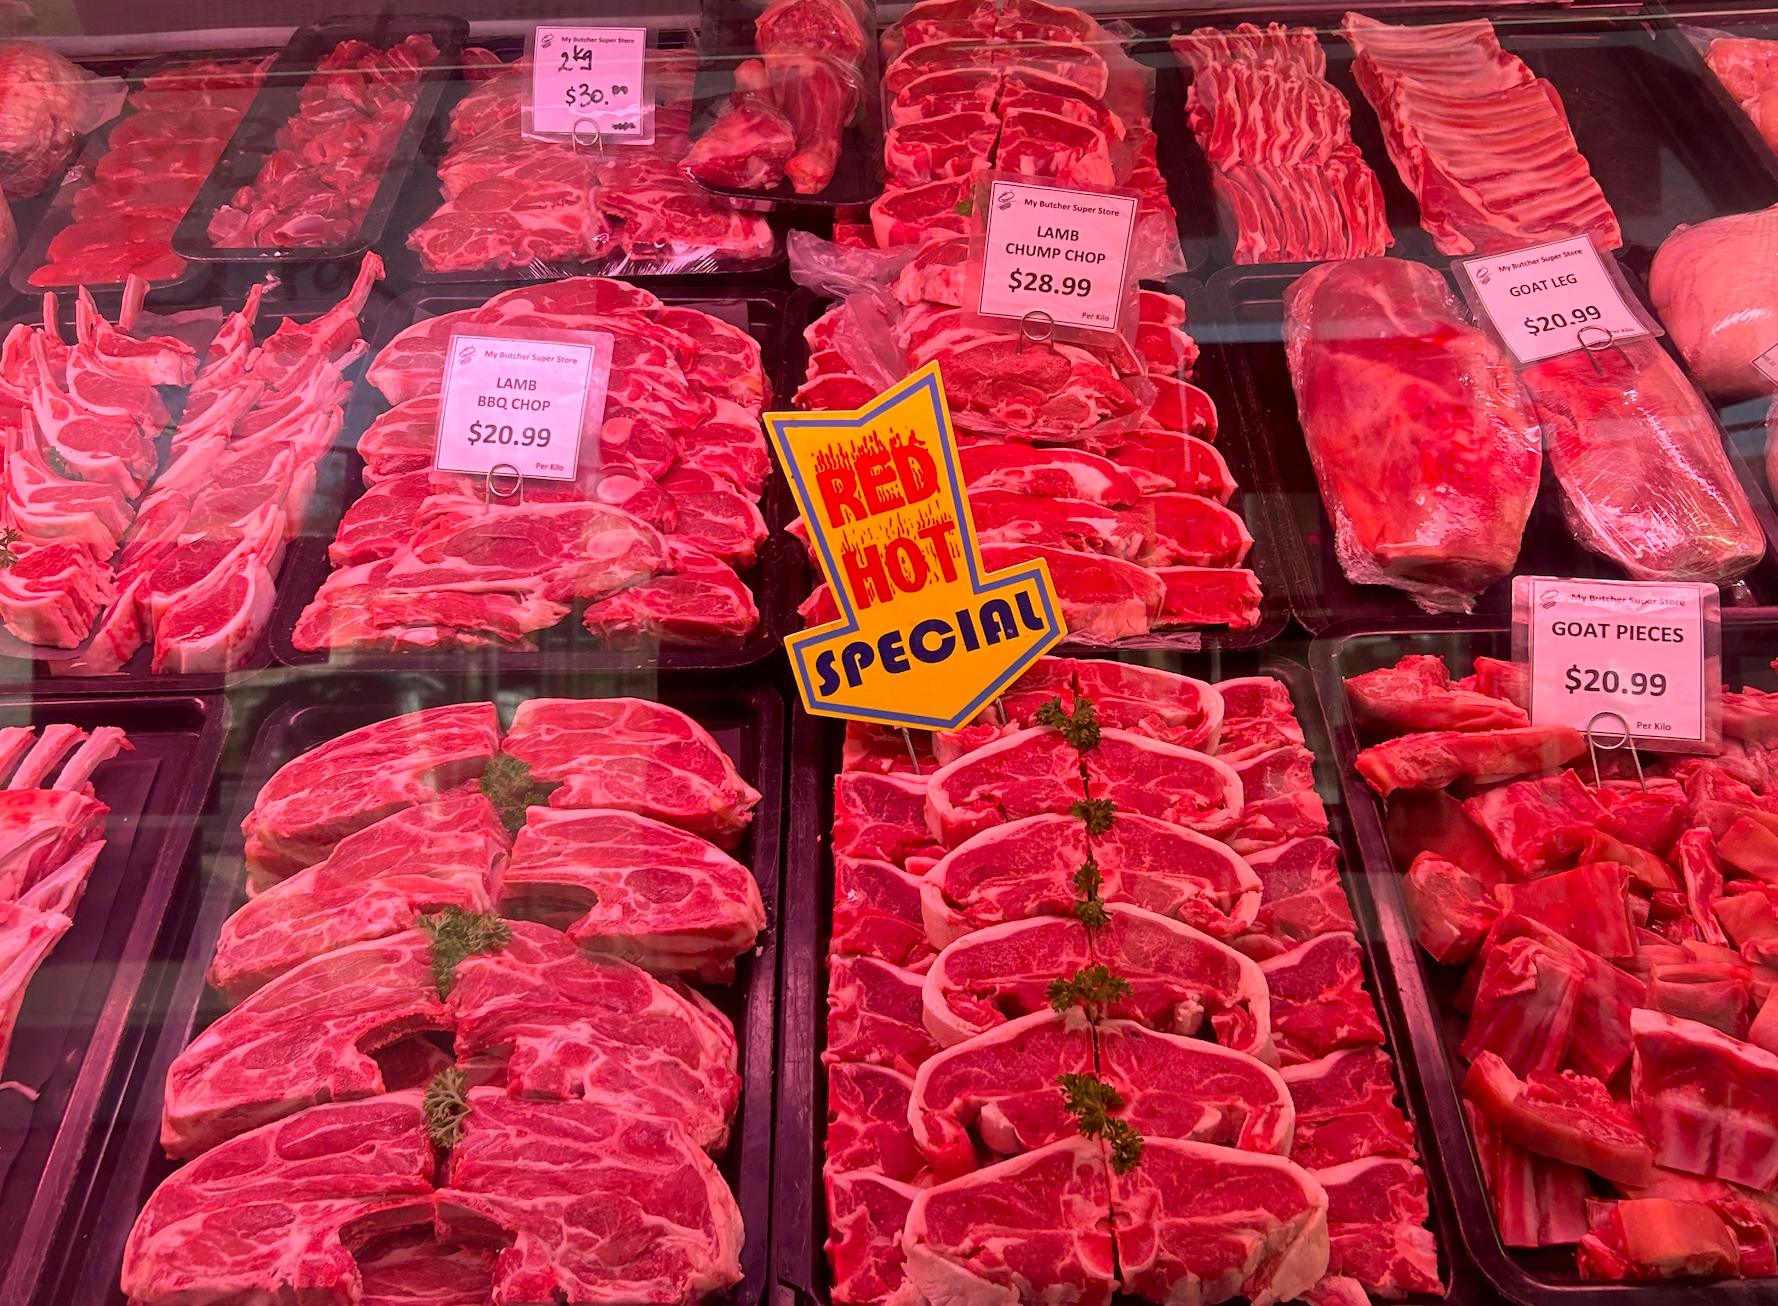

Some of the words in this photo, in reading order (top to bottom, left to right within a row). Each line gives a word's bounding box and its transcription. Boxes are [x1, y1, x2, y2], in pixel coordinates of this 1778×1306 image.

[1024, 198, 1038, 208] My
[1039, 200, 1071, 211] Butcher
[1072, 204, 1096, 214] Super
[1097, 207, 1119, 217] Store
[1037, 226, 1079, 241] LAMB
[1005, 242, 1060, 259] CHUMP
[1065, 249, 1106, 264] CHOP
[1498, 265, 1511, 273] My
[1511, 257, 1540, 270] Butcher
[1540, 253, 1562, 264] Super
[1562, 248, 1583, 258] Store
[1008, 268, 1091, 297] $28.99
[1509, 279, 1549, 297] GOAT
[1551, 273, 1578, 288] LEG
[1081, 312, 1094, 320] Per
[1095, 313, 1110, 322] Kilo
[1524, 305, 1602, 336] $20.99
[484, 350, 498, 360] My
[500, 351, 531, 361] Butcher
[532, 354, 555, 364] Super
[556, 355, 578, 365] Store
[496, 377, 537, 391] LAMB
[477, 395, 508, 411] BBQ
[511, 398, 551, 412] CHOP
[467, 420, 551, 448] $20.99
[535, 462, 548, 471] Per
[550, 463, 564, 472] Kilo
[812, 432, 940, 529] RED
[841, 512, 960, 610] HOT
[1571, 593, 1587, 603] My
[1589, 594, 1626, 604] Butcher
[1629, 597, 1657, 607] Super
[1659, 598, 1686, 607] Store
[1551, 621, 1610, 639] GOAT
[1616, 624, 1684, 643] PIECES
[815, 590, 1047, 697] SPECIAL
[1565, 664, 1667, 697] $20.99
[1636, 721, 1652, 730] Per
[1654, 722, 1671, 731] Kilo
